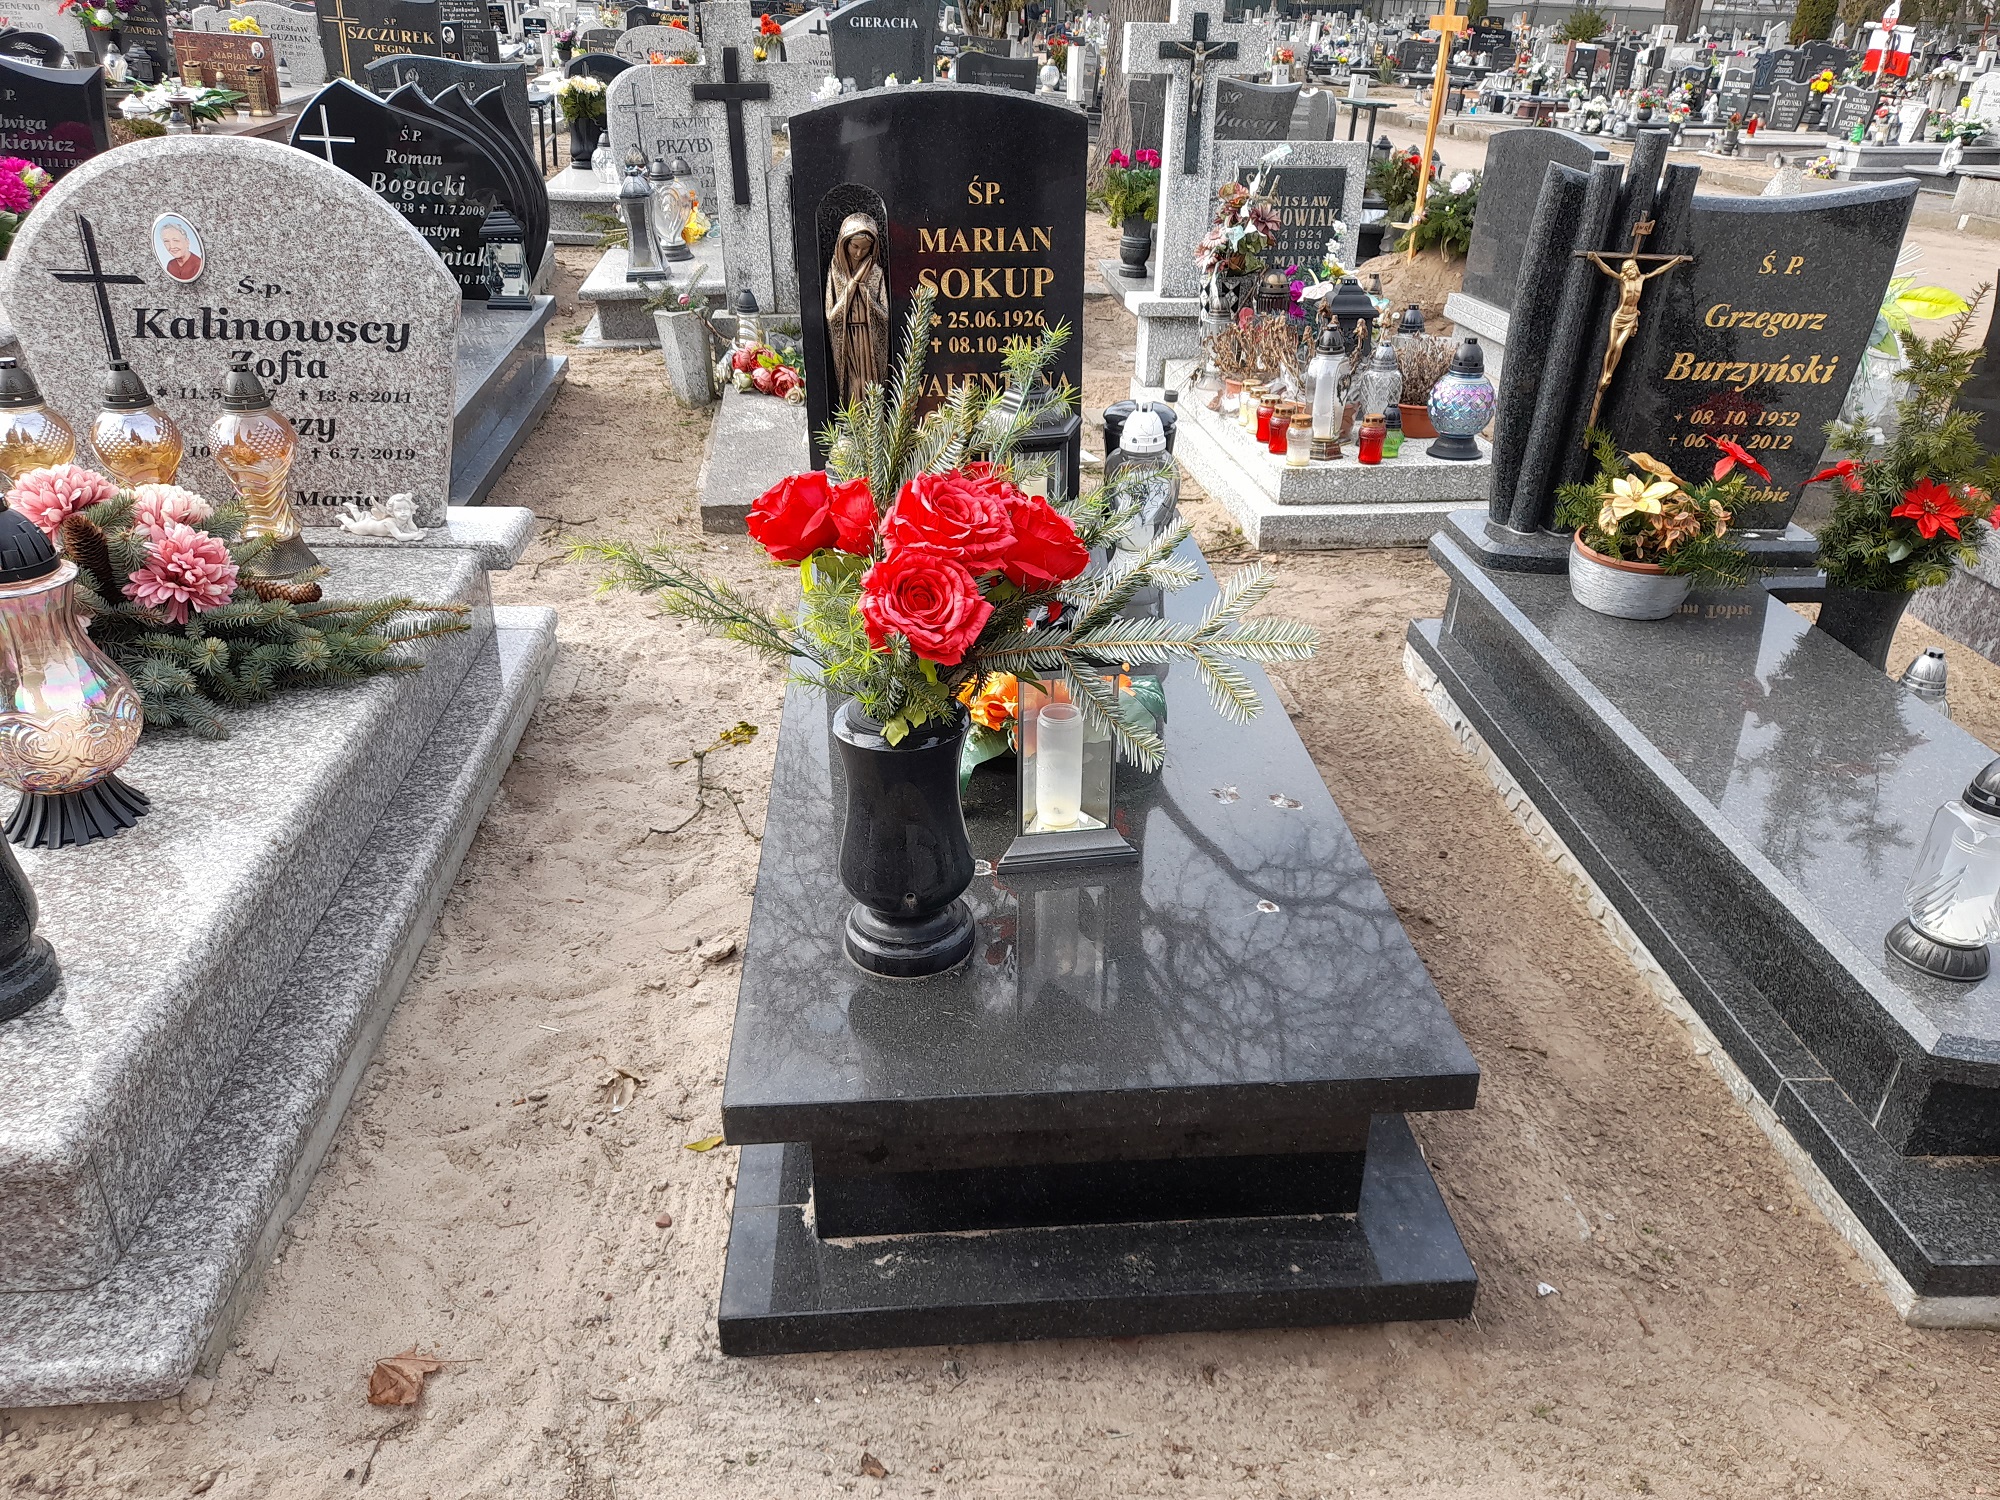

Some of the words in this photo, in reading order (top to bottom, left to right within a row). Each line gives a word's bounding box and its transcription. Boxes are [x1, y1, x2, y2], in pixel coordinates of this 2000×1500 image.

[123, 26, 163, 37] ZAPORA
[850, 16, 919, 29] GIERACHA
[270, 33, 311, 43] GUZMAN
[347, 26, 436, 45] SZCZUREK
[213, 52, 248, 61] MARIAN
[374, 43, 413, 54] REGINA
[400, 125, 422, 142] Ś.P.
[0, 133, 76, 153] kiewicz
[384, 148, 443, 166] Roman
[370, 171, 467, 200] Bogacki
[967, 175, 1005, 205] ŚP.
[434, 204, 486, 216] 11.7.2008
[1273, 195, 1332, 207] NISŁAW
[1273, 208, 1341, 227] OWIAK
[415, 224, 461, 241] ustyn
[918, 225, 1054, 254] MARIAN
[1295, 230, 1323, 239] 1924
[1294, 241, 1321, 250] 1986
[237, 275, 292, 297] Ś.p.
[918, 267, 1055, 299] SOKUP
[947, 309, 1046, 329] 25.06.1926
[1704, 303, 1828, 338] Grzegorz
[132, 306, 412, 353] Kalinowscy
[230, 350, 329, 385] Zofia
[1664, 352, 1839, 393] Burzyński
[316, 390, 341, 402] 13.
[370, 391, 412, 403] 2011
[1690, 409, 1716, 425] 08.
[1723, 410, 1748, 426] 10.
[1756, 411, 1800, 427] 1952
[1683, 432, 1709, 448] 06.
[1747, 434, 1793, 450] 2012
[370, 449, 416, 460] 2019
